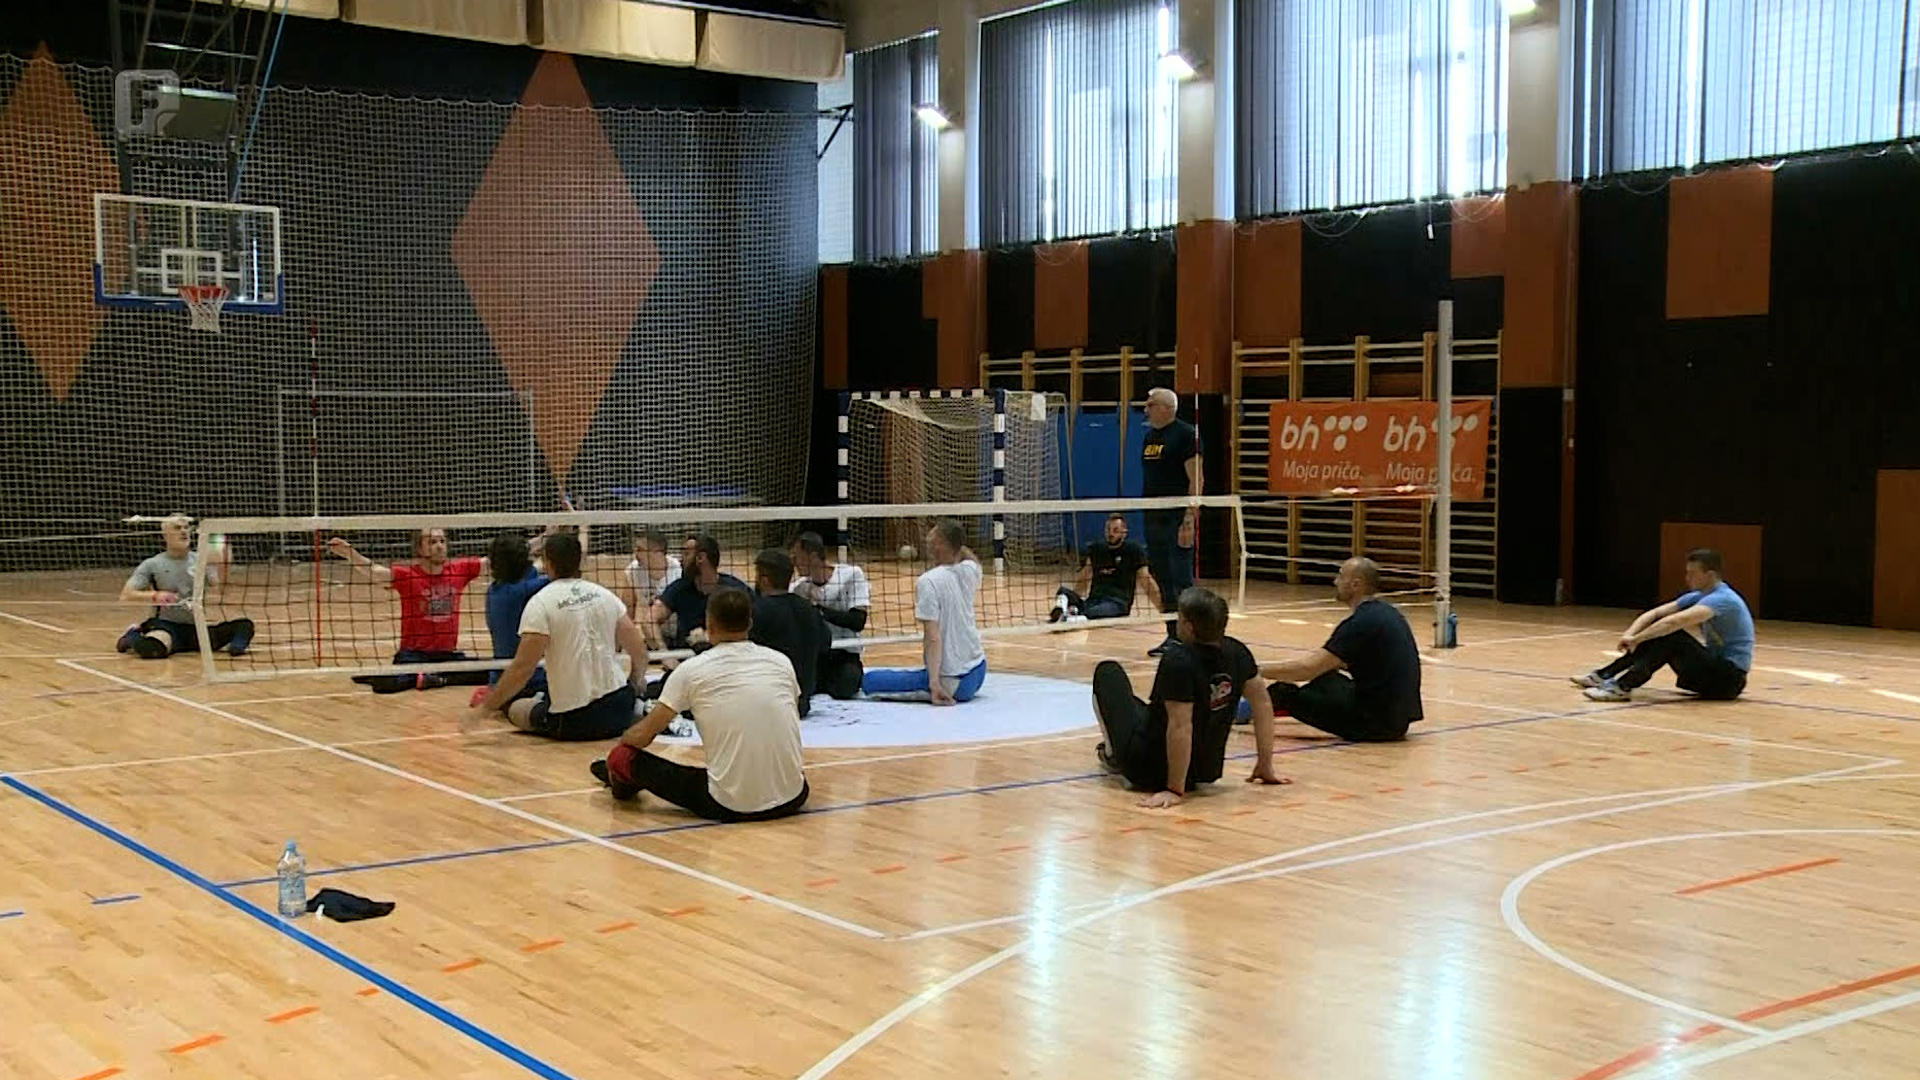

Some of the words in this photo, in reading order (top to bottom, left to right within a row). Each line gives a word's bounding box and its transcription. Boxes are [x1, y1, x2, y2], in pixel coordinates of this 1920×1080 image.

[1281, 415, 1320, 451] bh
[1383, 415, 1427, 452] bh
[1283, 461, 1319, 483] Moja
[1321, 461, 1364, 482] priča.
[1386, 462, 1425, 484] Moja
[1427, 463, 1476, 485] pča.
